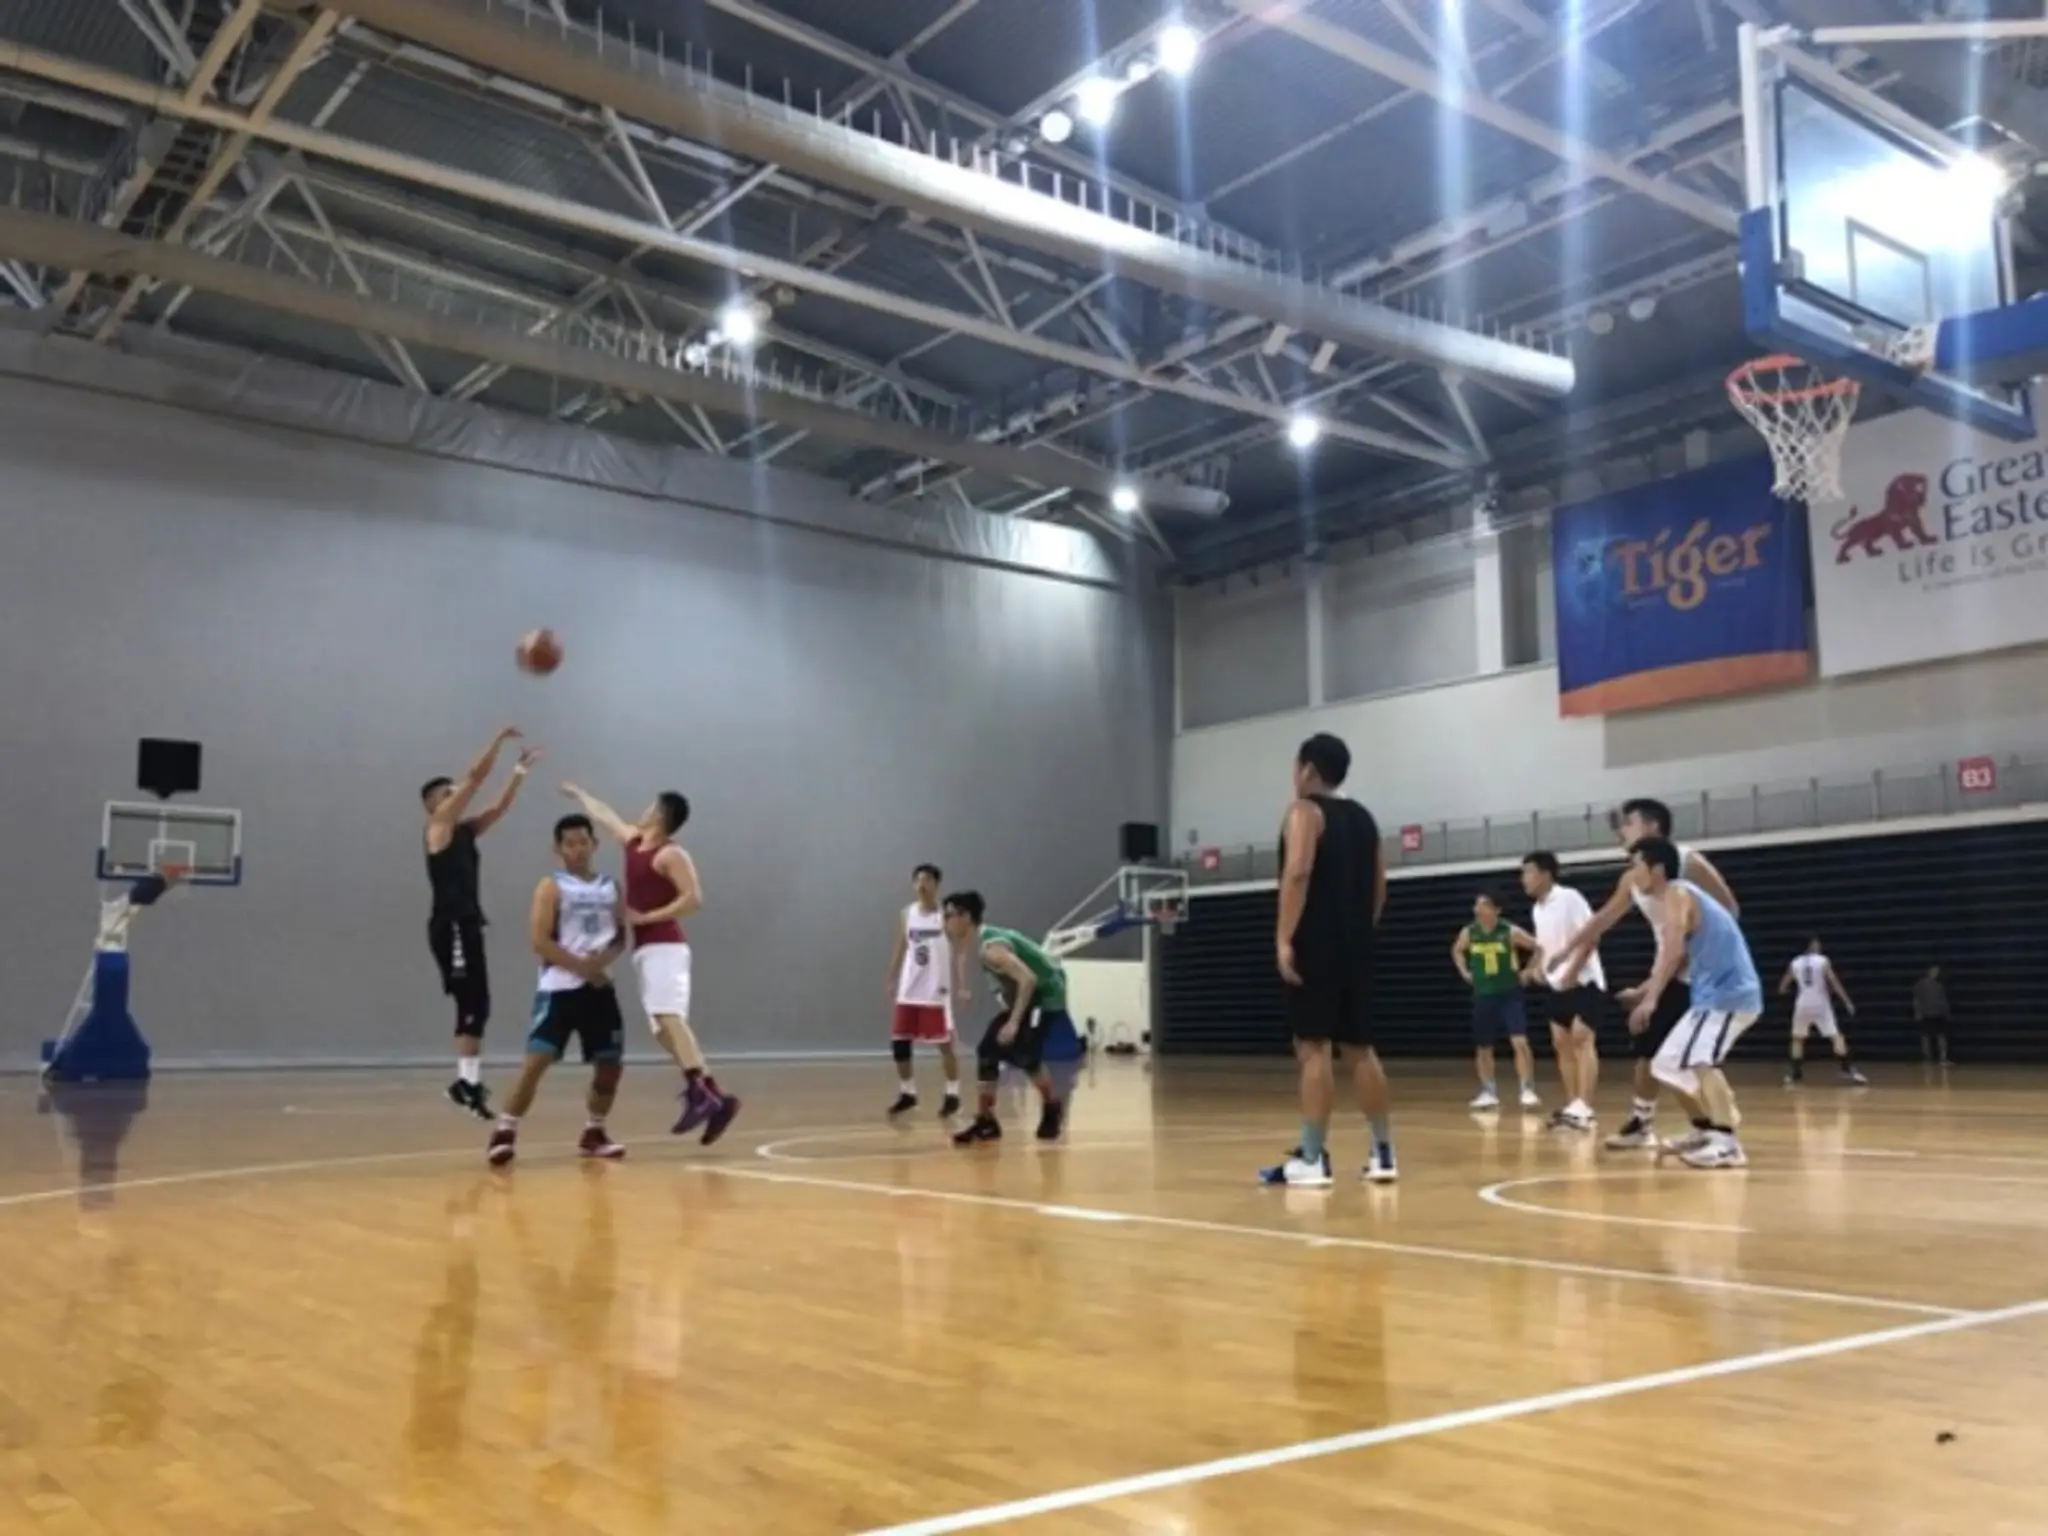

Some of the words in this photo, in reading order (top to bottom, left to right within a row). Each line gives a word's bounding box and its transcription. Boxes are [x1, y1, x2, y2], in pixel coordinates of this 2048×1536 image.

[1940, 446, 2048, 499] Grea
[1605, 517, 1773, 612] Tiger
[1898, 551, 1954, 583] Life
